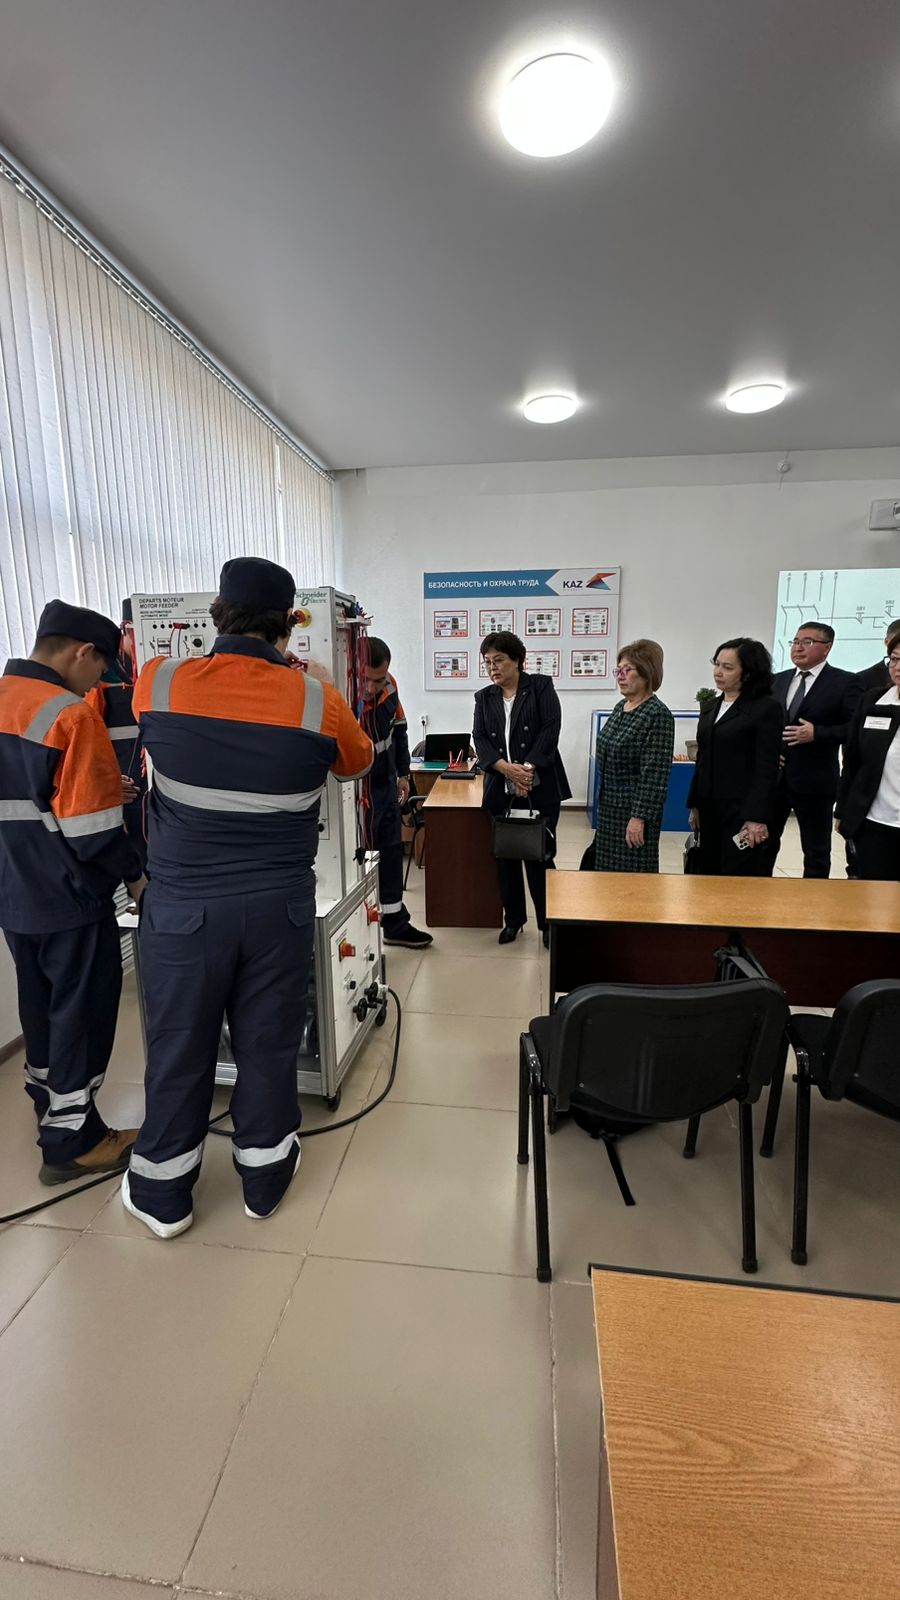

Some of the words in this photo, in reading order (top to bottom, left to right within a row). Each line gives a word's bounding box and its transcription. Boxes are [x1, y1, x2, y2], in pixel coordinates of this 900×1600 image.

[428, 581, 482, 589] БЕЗОПАСНОСТЬ
[483, 580, 488, 588] И
[489, 580, 517, 588] ОХРАНА
[518, 579, 540, 588] ТРУДА
[563, 580, 583, 589] KAZ
[295, 591, 328, 599] Schneider
